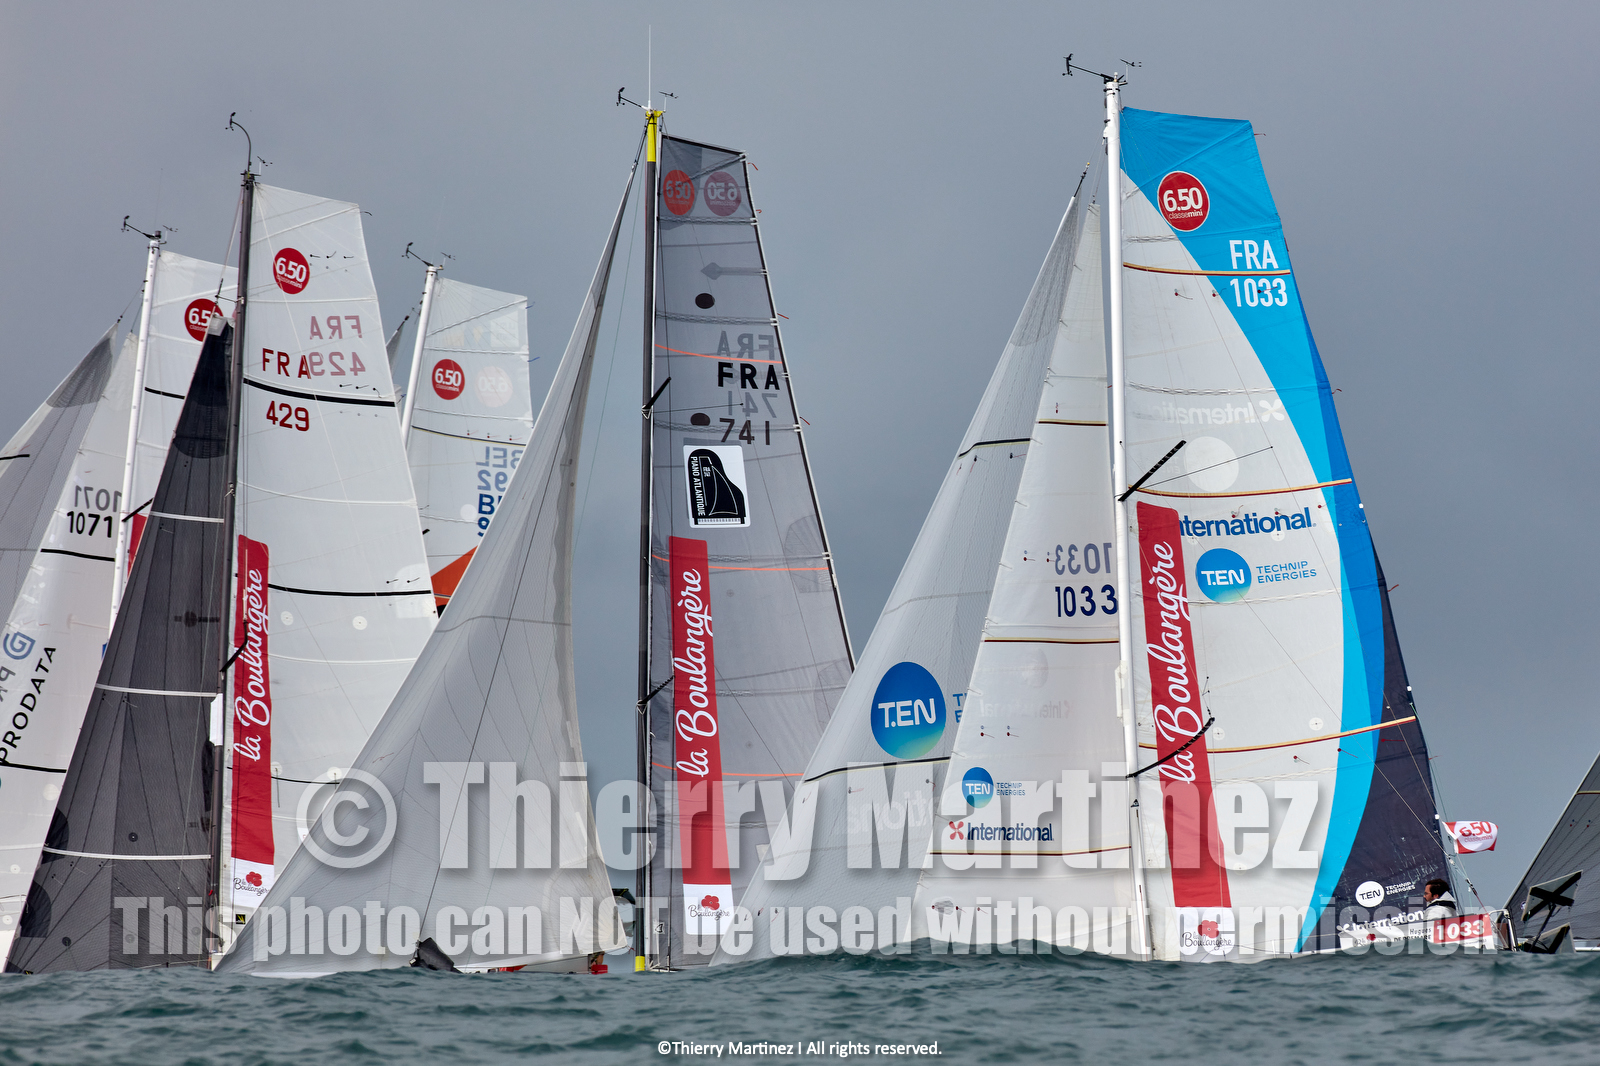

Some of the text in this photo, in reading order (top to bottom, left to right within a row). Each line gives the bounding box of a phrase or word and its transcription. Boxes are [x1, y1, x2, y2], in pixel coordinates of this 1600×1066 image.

[1163, 187, 1203, 212] 6.50
[1169, 209, 1203, 220] classemini
[1229, 240, 1279, 269] FRA
[276, 257, 307, 283] 6.50
[1230, 278, 1288, 307] 1033
[189, 307, 221, 326] 6.5
[262, 347, 312, 379] FRA
[717, 361, 780, 390] FRA
[435, 368, 462, 387] 6.50
[266, 400, 310, 432] 429
[719, 417, 771, 446] 741
[690, 456, 705, 516] PIANO ATLANTIQUE
[67, 510, 113, 538] 1071
[1200, 568, 1245, 586] T.EN
[1256, 561, 1308, 575] TECHNIP
[1257, 569, 1317, 584] ENERGIES
[1055, 584, 1119, 617] 1033
[674, 568, 717, 778] la Boulangère
[1146, 541, 1201, 784] la Boulangère
[0, 647, 57, 766] PRODATA
[878, 698, 937, 728] T.EN
[233, 735, 262, 761] la
[965, 783, 990, 795] T.EN
[967, 822, 1053, 841] International
[1459, 821, 1492, 837] 6.50
[1436, 921, 1485, 940] 1033
